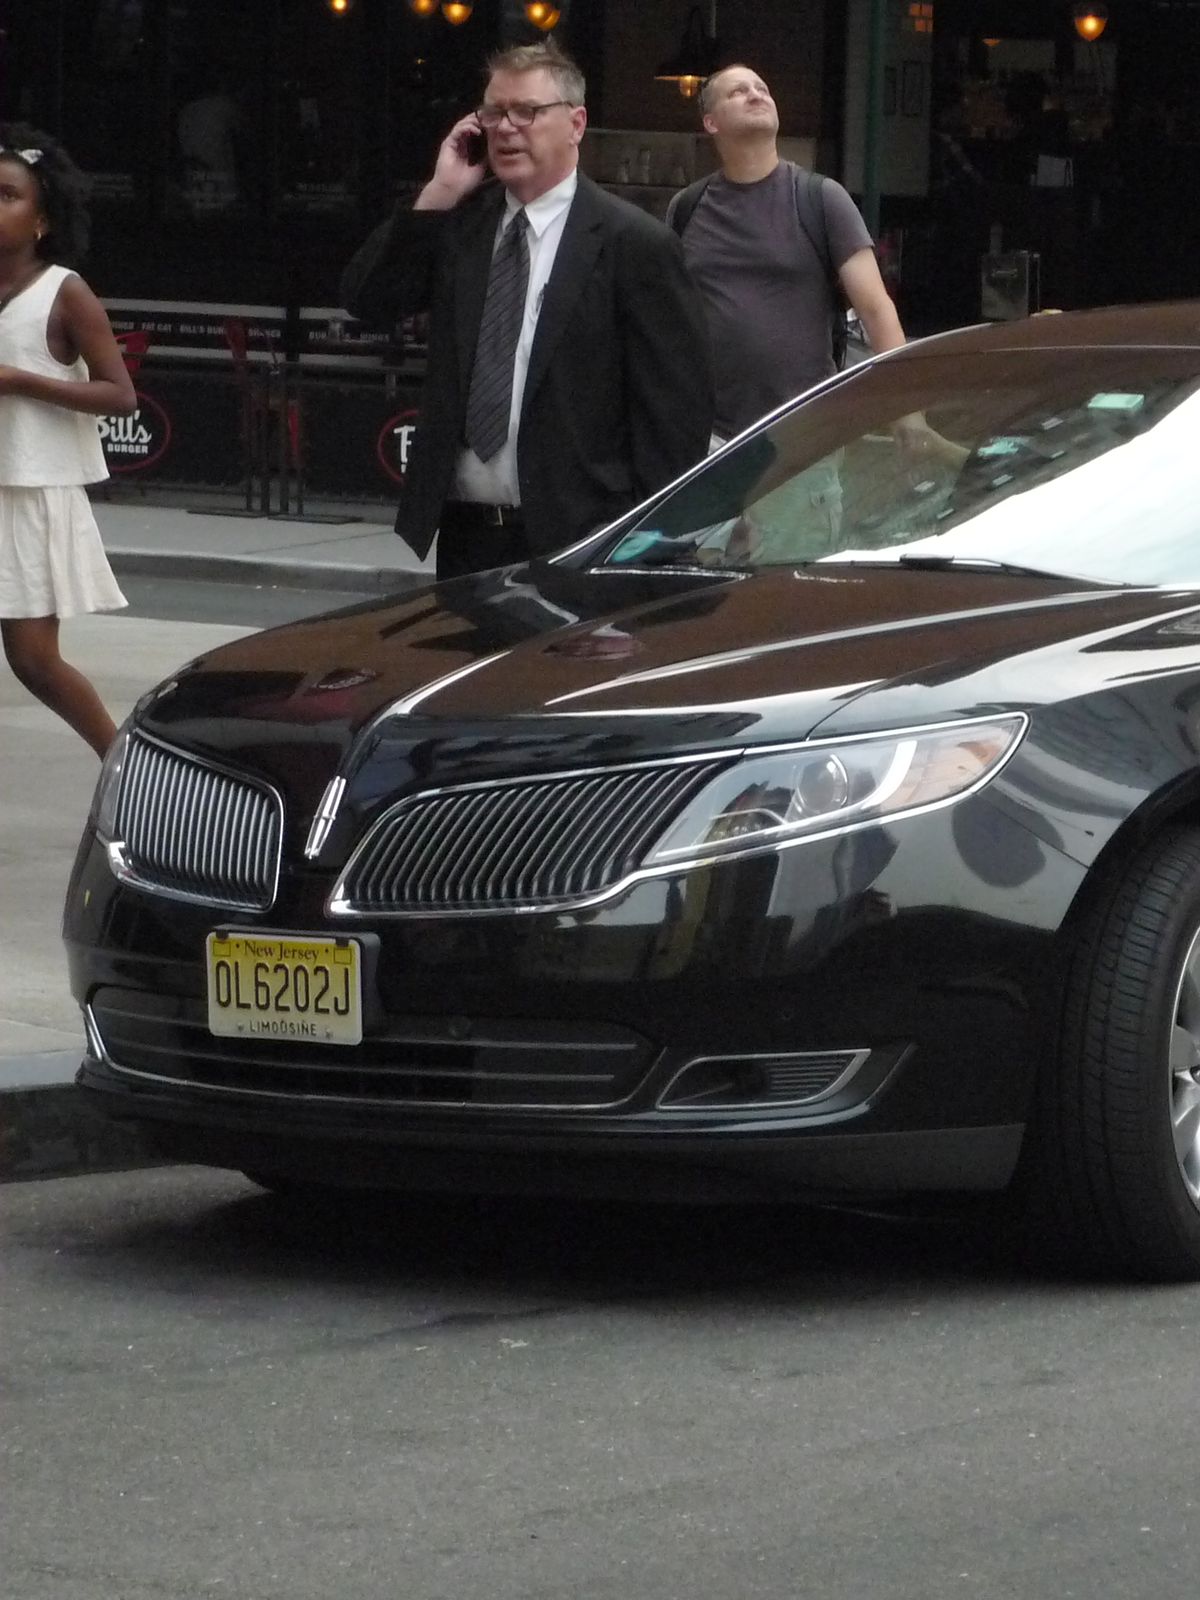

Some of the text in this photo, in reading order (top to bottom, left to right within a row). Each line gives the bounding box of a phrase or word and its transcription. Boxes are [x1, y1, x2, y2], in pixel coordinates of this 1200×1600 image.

[107, 443, 149, 454] BURGER
[244, 940, 320, 962] New Jersey
[249, 1020, 317, 1037] LIMOUSINE
